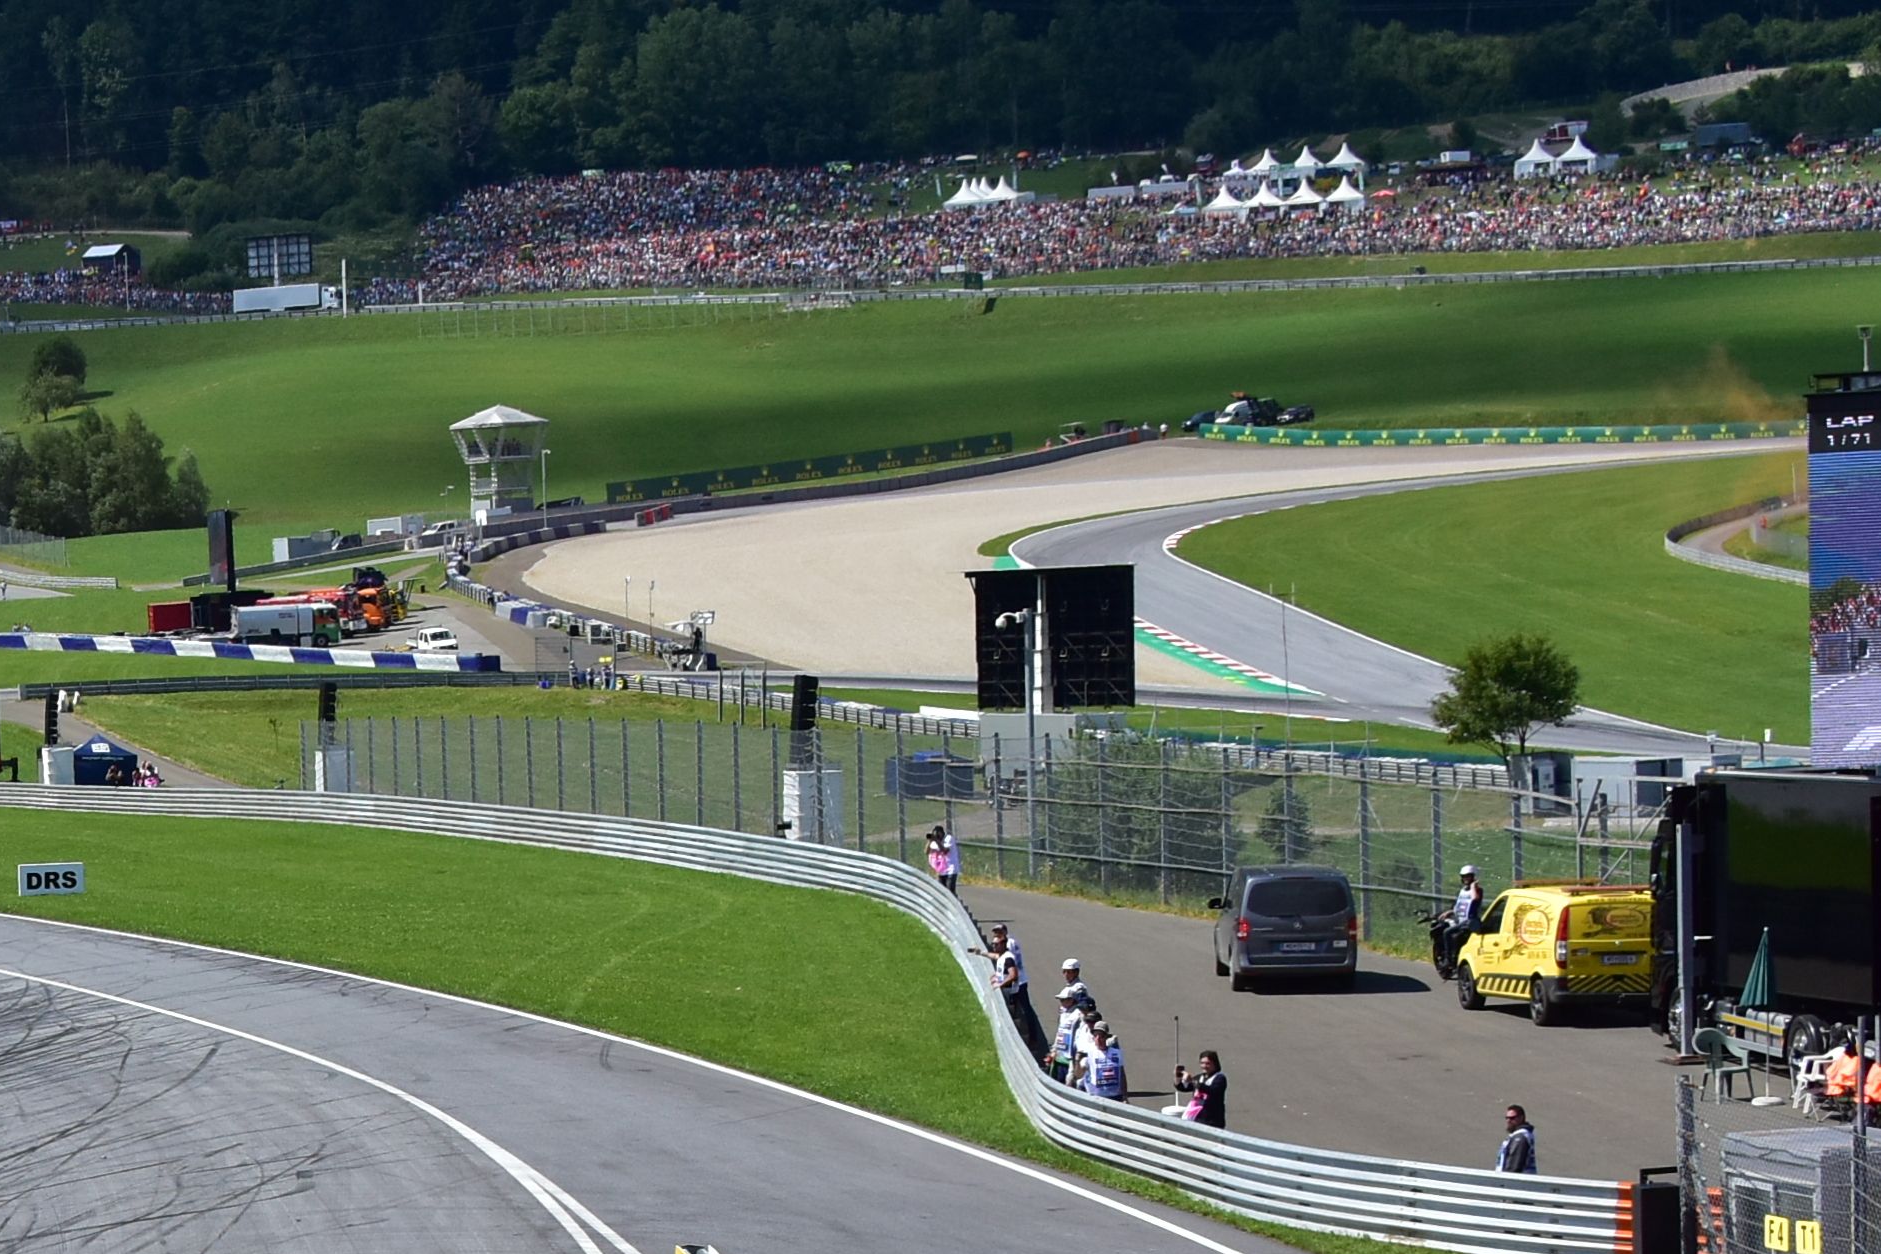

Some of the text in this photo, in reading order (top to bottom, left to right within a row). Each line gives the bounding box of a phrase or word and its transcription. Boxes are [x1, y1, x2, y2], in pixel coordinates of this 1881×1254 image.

[1826, 415, 1874, 428] LAP
[26, 871, 77, 890] DRS
[1769, 1219, 1784, 1246] F4
[1800, 1225, 1816, 1250] T1
